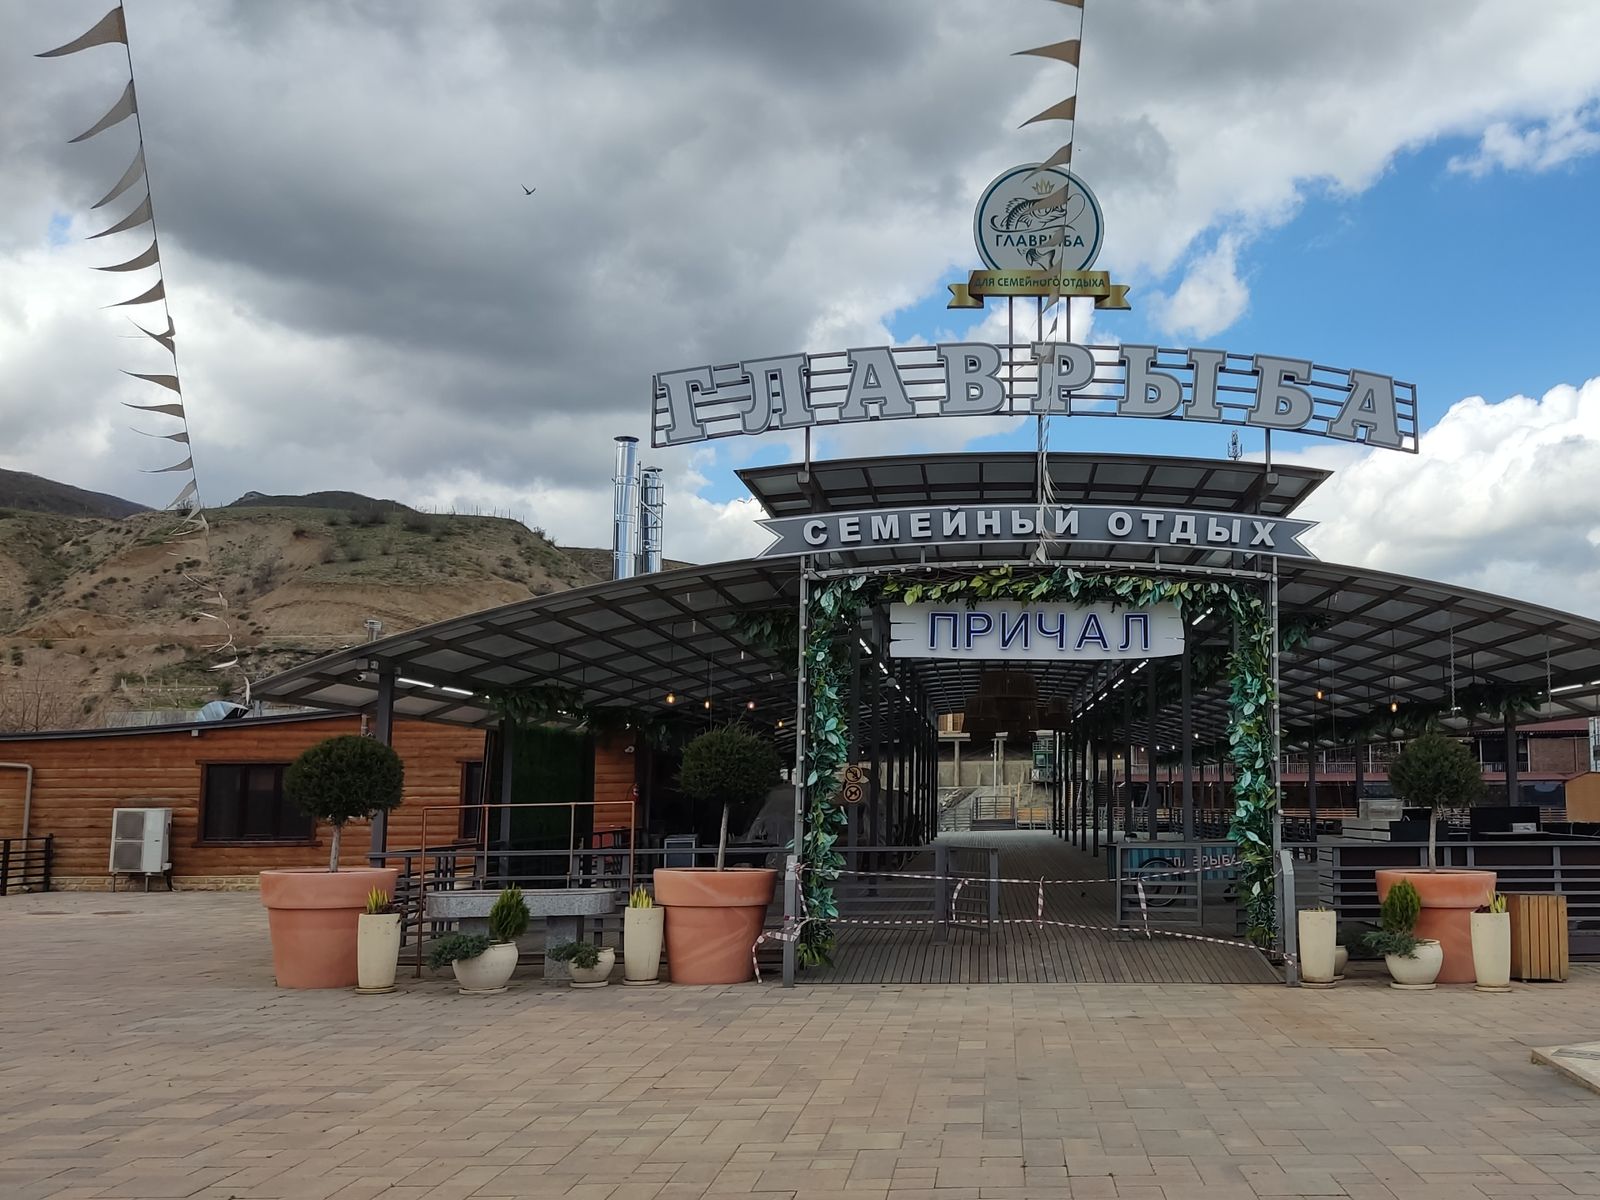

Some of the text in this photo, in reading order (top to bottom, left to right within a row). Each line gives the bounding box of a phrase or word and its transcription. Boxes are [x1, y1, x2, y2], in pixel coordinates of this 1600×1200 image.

[995, 234, 1085, 247] ГЛАВРБА
[974, 275, 1105, 289] ДЛЯ СЕМЕЙНОГО ОТДЫХА
[656, 341, 1404, 452] ГЛАВРЫБА
[802, 505, 1277, 546] СЕМЕЙНЫЙ ОТДЫХ
[928, 611, 1150, 650] ПРИЧАЛ
